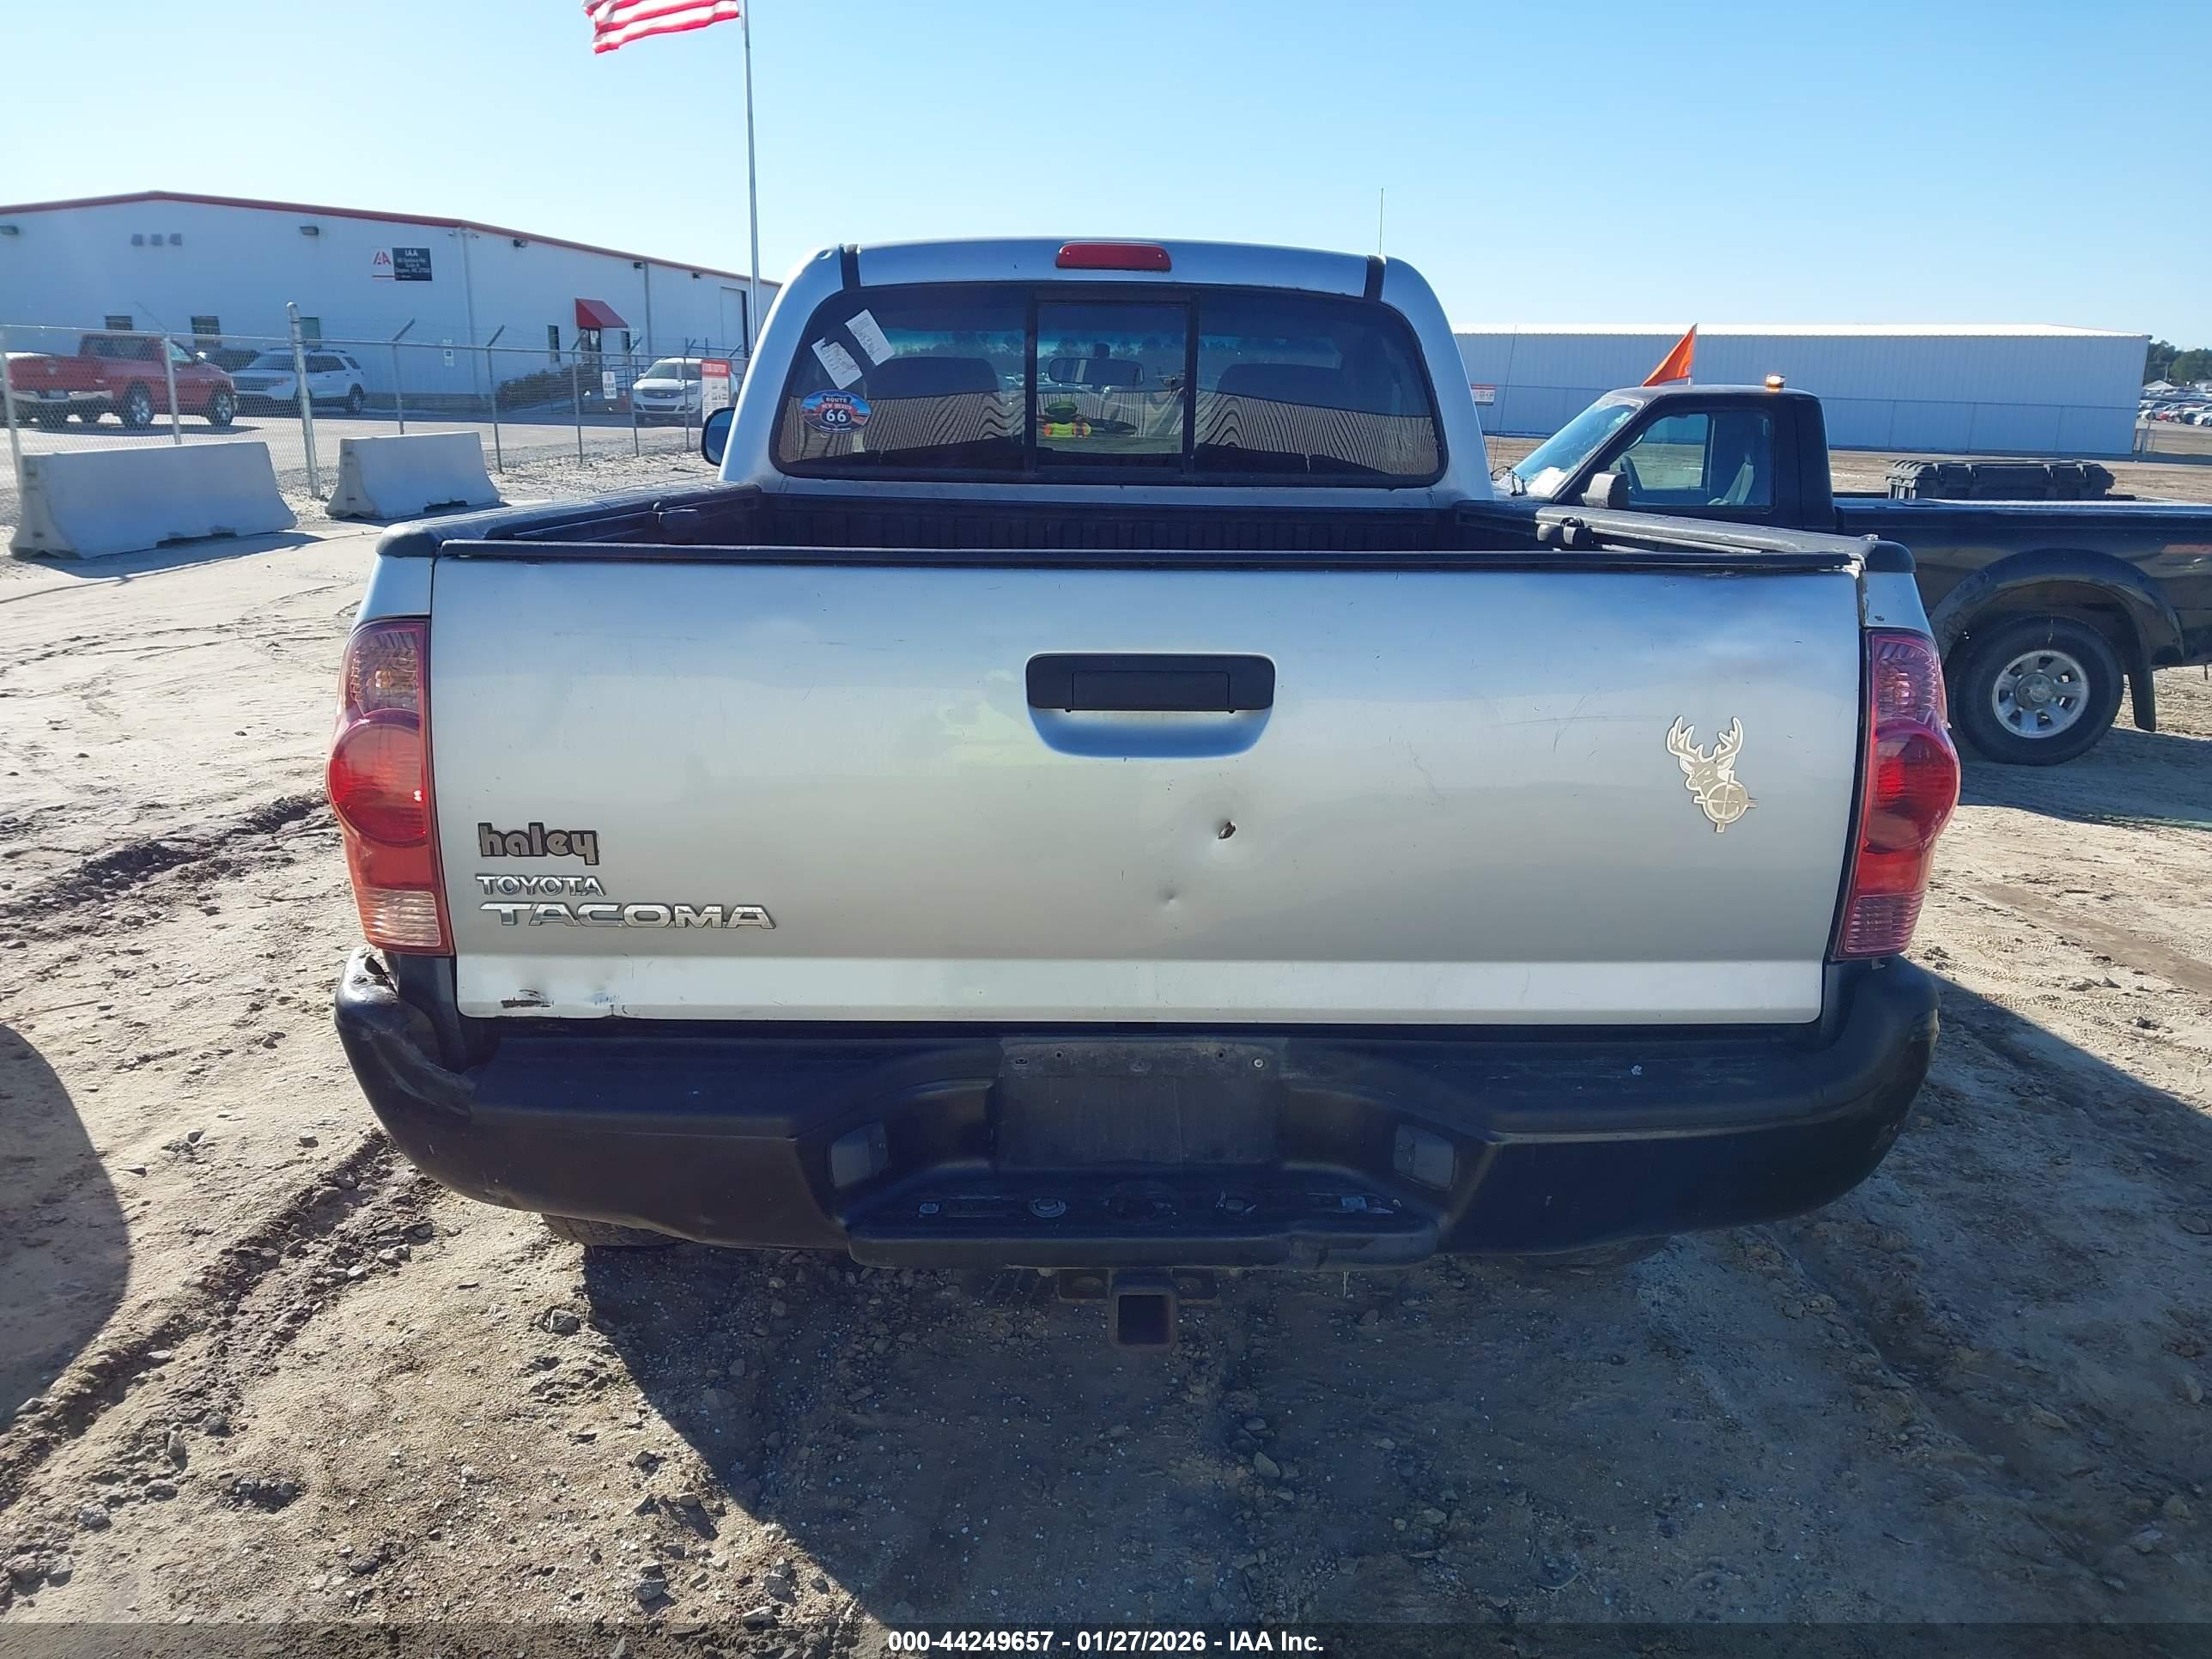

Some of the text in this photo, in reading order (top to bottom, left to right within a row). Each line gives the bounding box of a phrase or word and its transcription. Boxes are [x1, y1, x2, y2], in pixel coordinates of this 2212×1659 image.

[826, 409, 847, 422] 66
[477, 822, 599, 866] haley
[476, 872, 605, 896] TOYOTA
[480, 902, 776, 929] TACOMA
